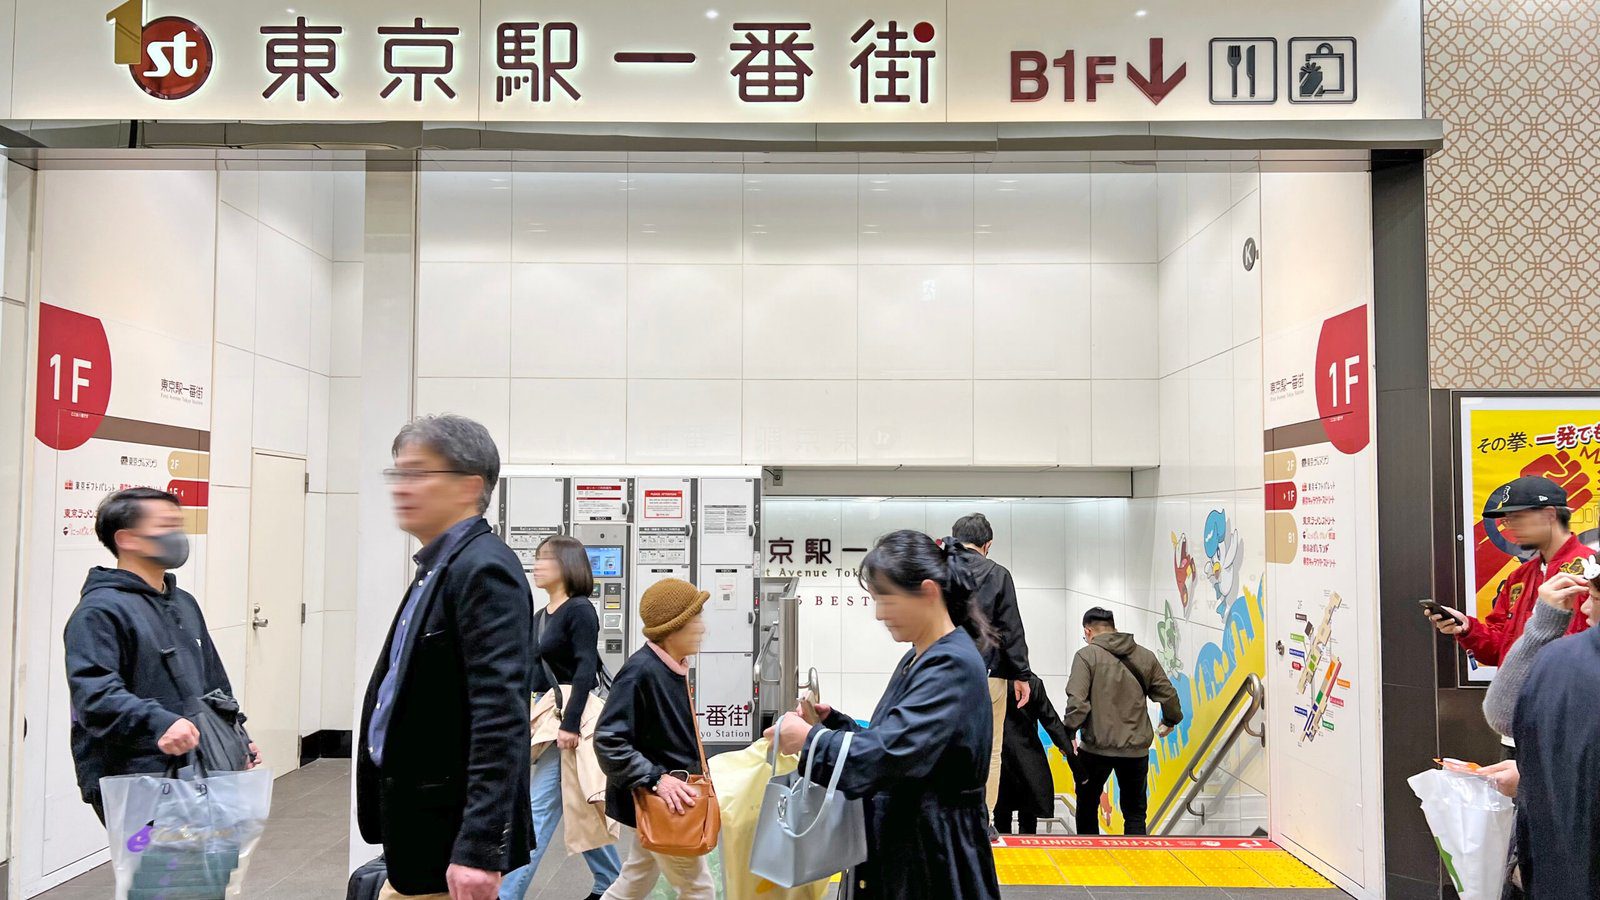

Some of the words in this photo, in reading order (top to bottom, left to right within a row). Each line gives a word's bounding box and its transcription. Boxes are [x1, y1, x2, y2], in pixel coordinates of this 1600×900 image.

[260, 16, 936, 103] 東京駅一番街
[1010, 50, 1116, 102] B1F
[49, 353, 92, 404] 1F
[1329, 354, 1360, 408] 1F
[63, 508, 96, 519] 東京ラーメン
[768, 536, 868, 564] 京駅一
[778, 567, 828, 578] Avenue
[815, 595, 871, 606] BEST
[701, 730, 712, 739] yo
[715, 730, 750, 738] Station
[1020, 838, 1093, 846] COUNTER
[1100, 839, 1174, 847] TAX-FREE
